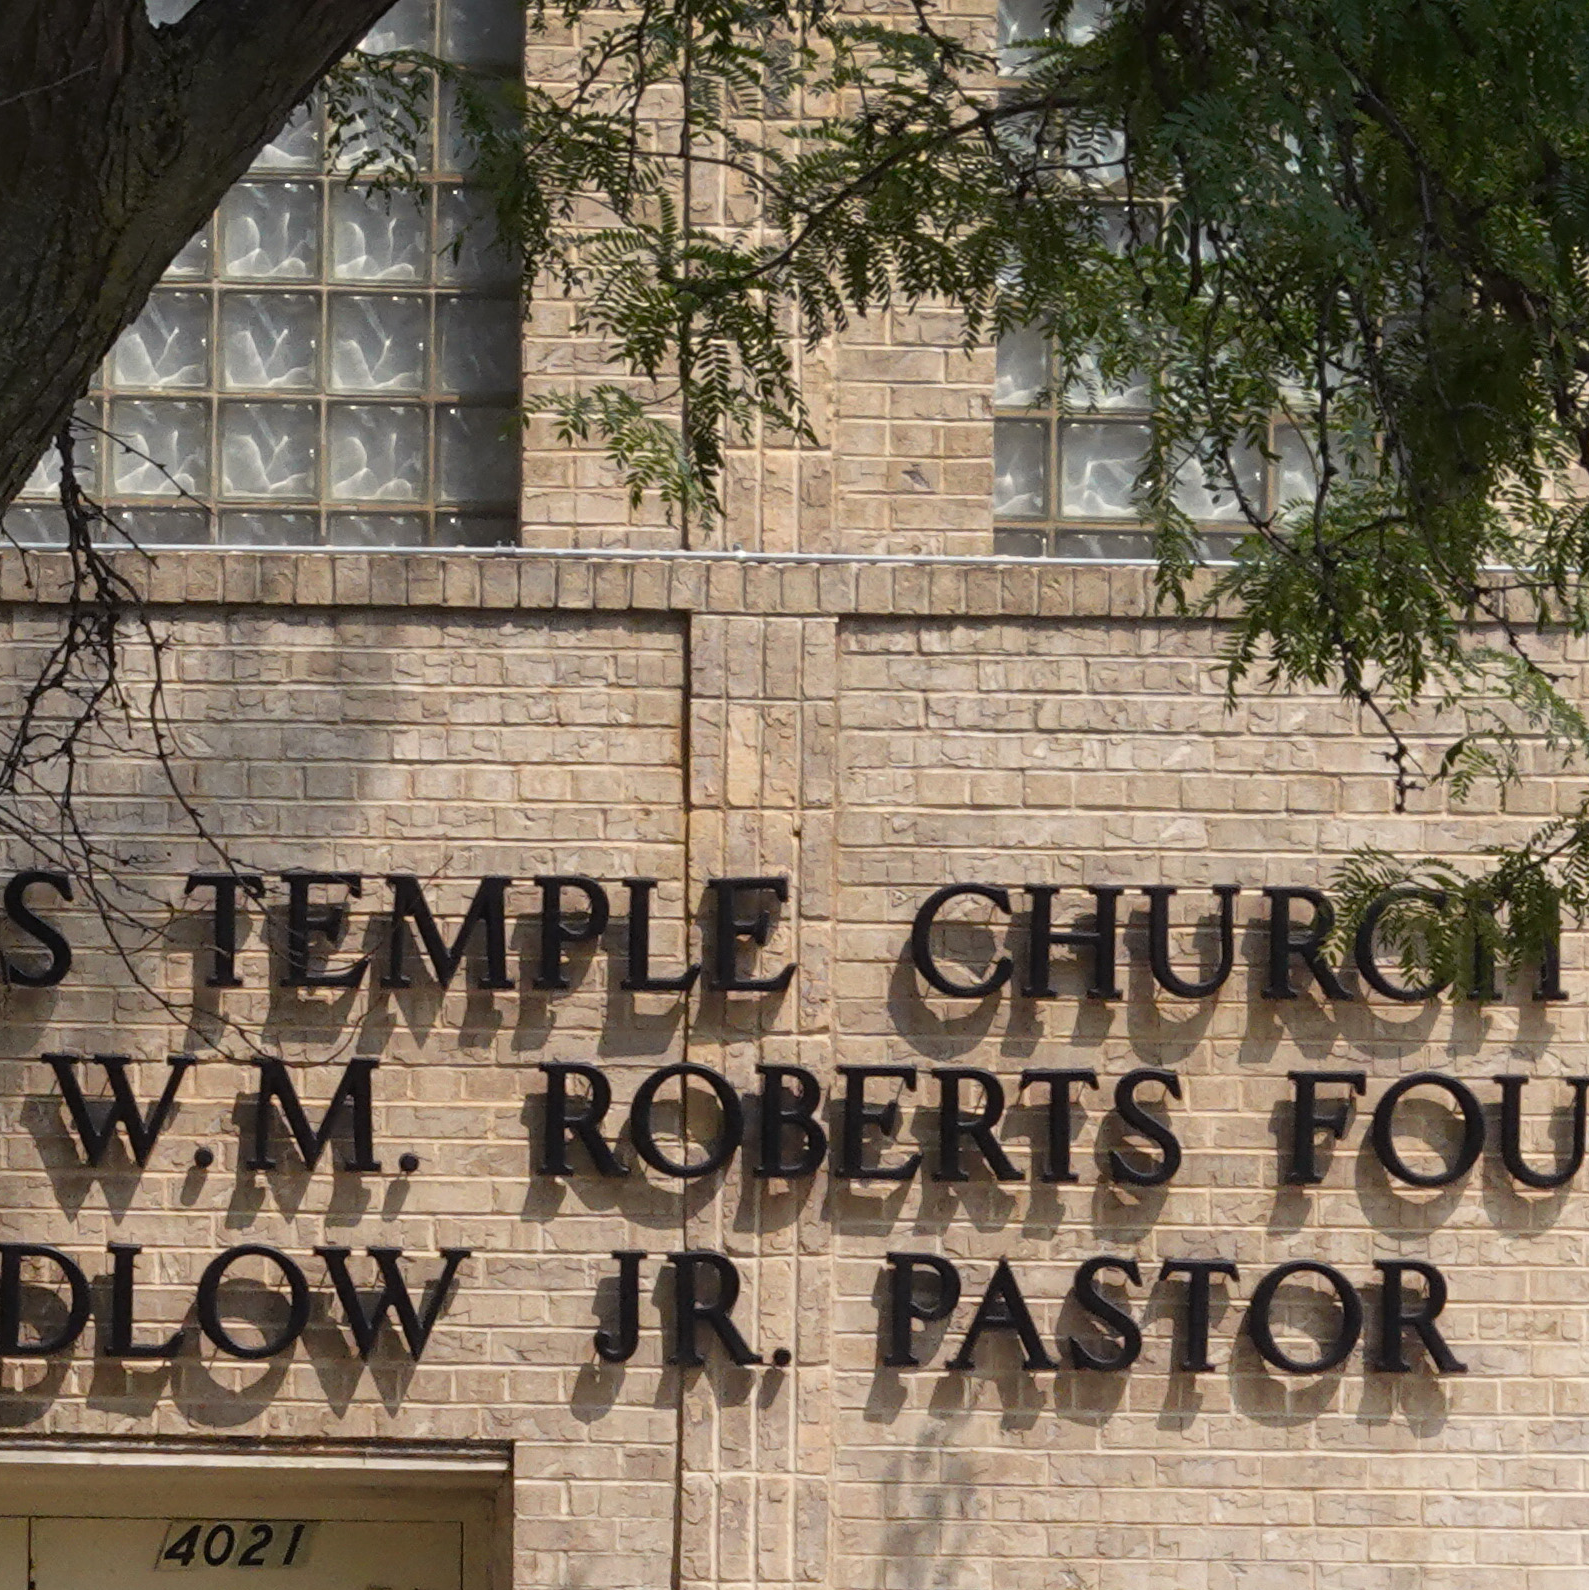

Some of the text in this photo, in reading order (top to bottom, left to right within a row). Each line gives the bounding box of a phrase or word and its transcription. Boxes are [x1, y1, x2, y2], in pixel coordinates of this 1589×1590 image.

[186, 872, 796, 993] TEMPLE
[539, 1061, 1183, 1188] ROBERTS
[595, 1249, 792, 1369] JR.
[883, 1251, 1468, 1375] PASTOR
[163, 1523, 307, 1567] 4021
